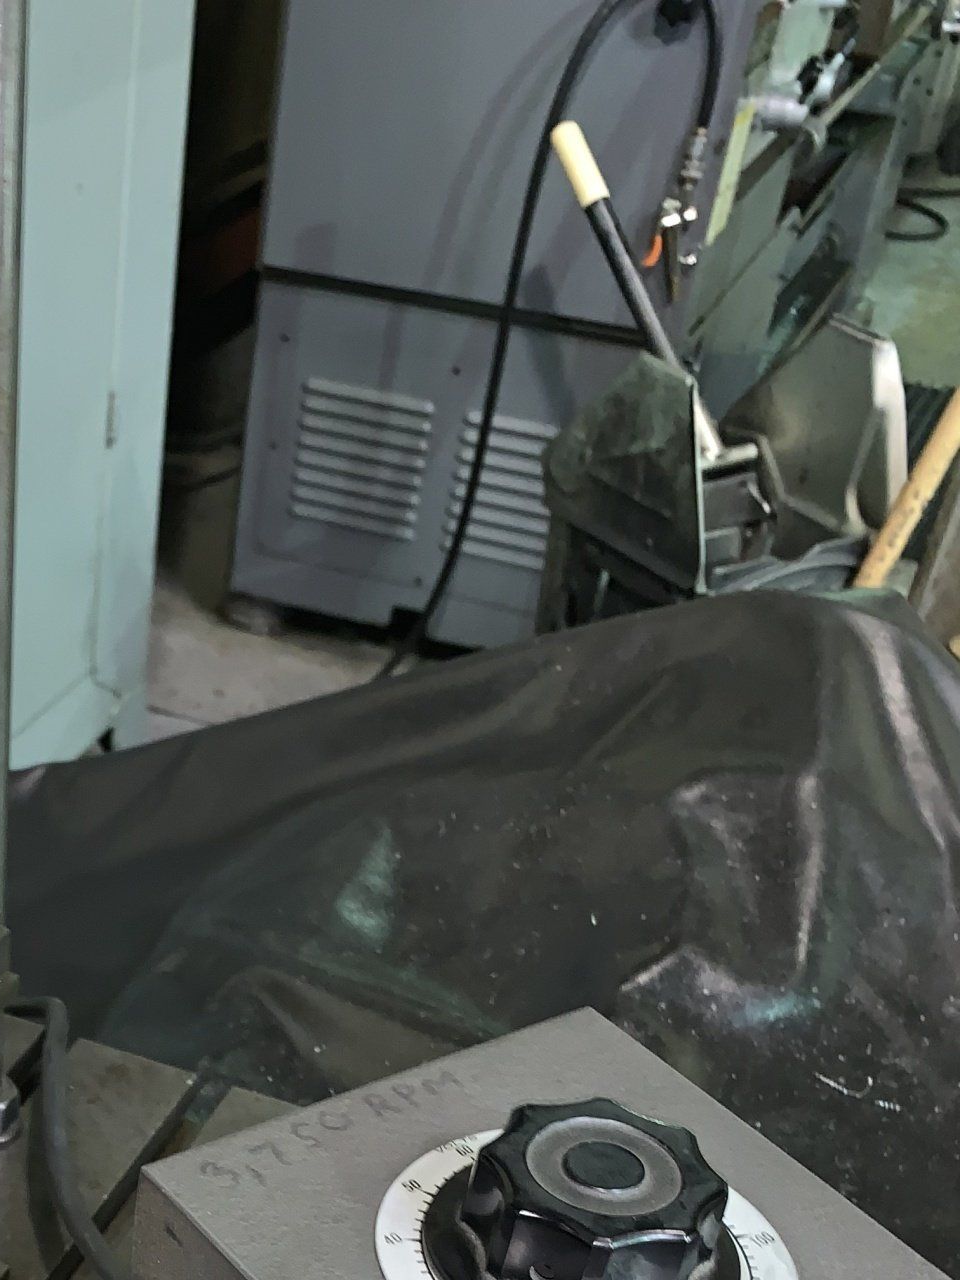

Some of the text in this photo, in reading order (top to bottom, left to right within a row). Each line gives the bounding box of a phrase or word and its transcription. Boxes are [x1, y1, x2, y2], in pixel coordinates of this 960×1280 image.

[362, 1071, 464, 1118] RPM
[402, 1179, 421, 1192] 50
[384, 1232, 402, 1245] 40
[750, 1231, 775, 1248] 100
